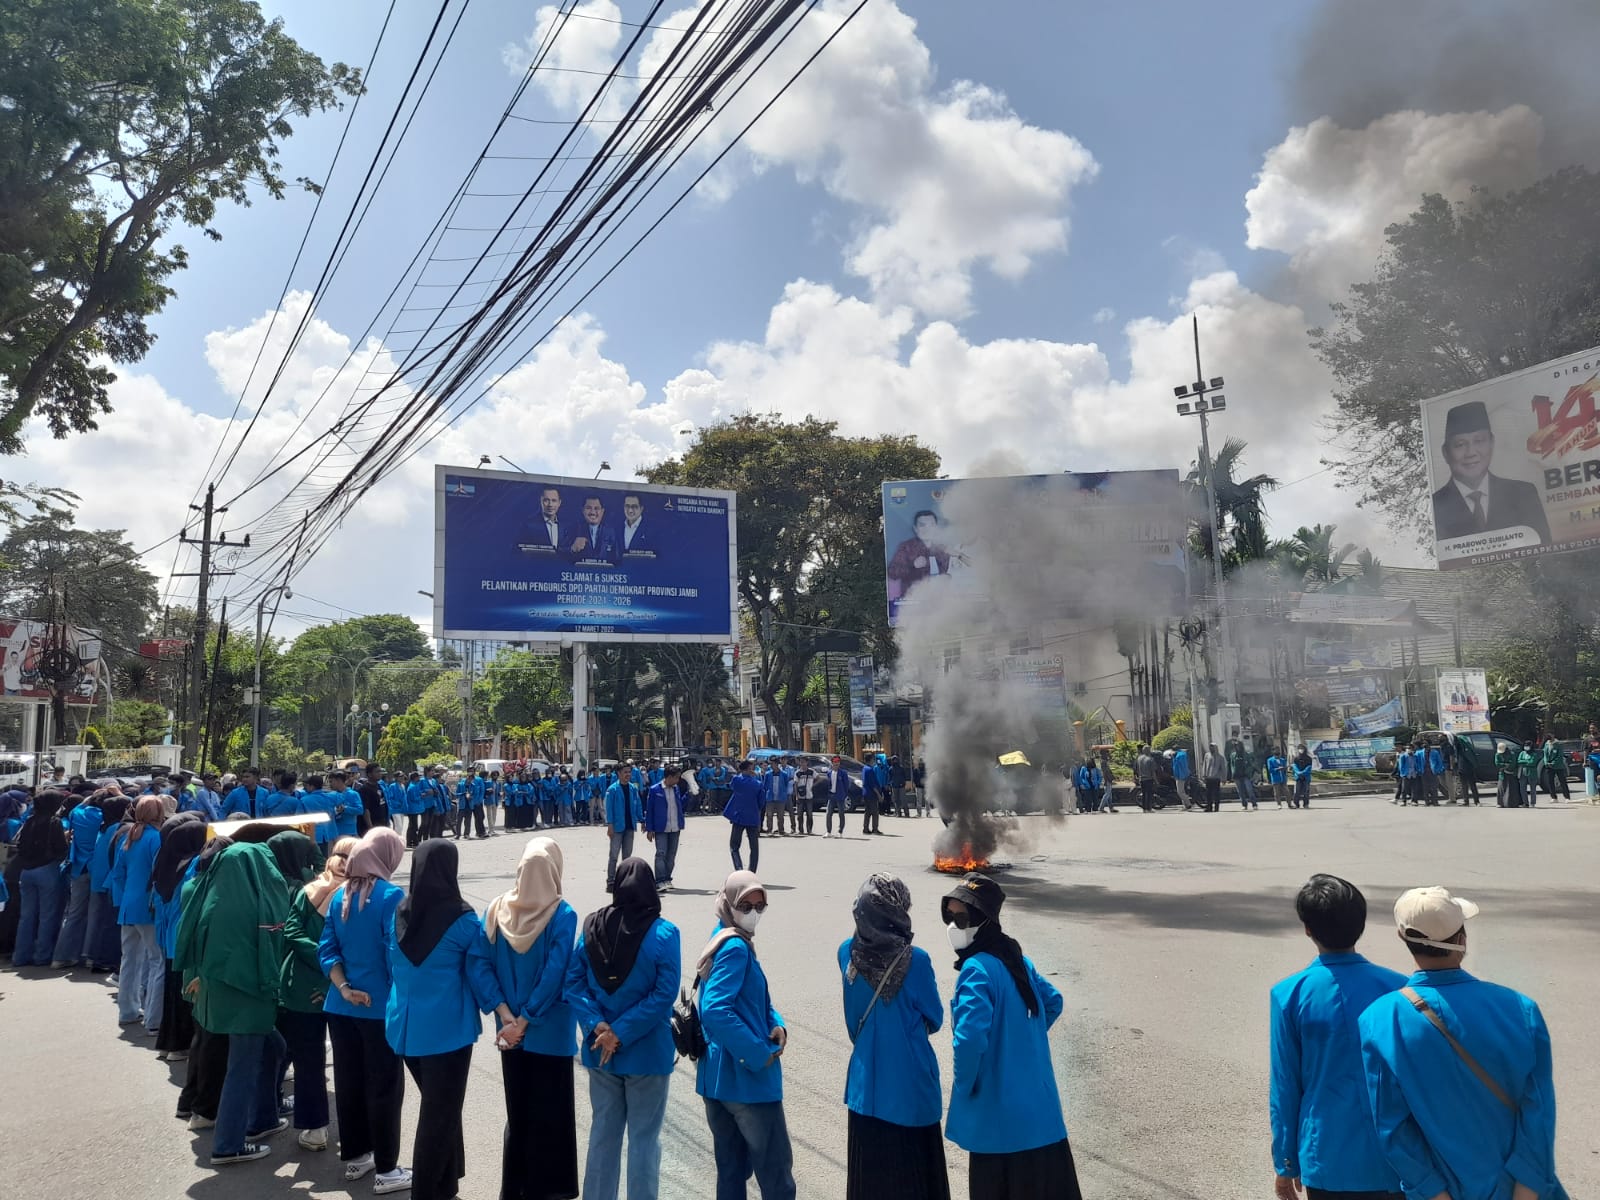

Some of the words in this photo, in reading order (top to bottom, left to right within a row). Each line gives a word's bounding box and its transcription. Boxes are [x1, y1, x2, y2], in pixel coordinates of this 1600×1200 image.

[1453, 539, 1487, 550] PRABOWO
[1488, 532, 1524, 544] SUBIANTO
[1471, 553, 1511, 565] DISIPLIN
[1515, 543, 1566, 557] TERAPKAN
[561, 571, 593, 582] SELAMAT
[601, 574, 627, 584] SUKSES
[481, 580, 528, 591] PELANTIKAN
[529, 582, 567, 592] PENGURUS
[568, 583, 583, 593] DPD
[584, 584, 608, 593] PARTAI
[609, 585, 646, 595] DEMOKRAT
[647, 586, 677, 597] PROVINSI
[678, 588, 698, 598] JAMBI
[557, 594, 587, 604] PERIODE
[613, 597, 632, 606] 2026
